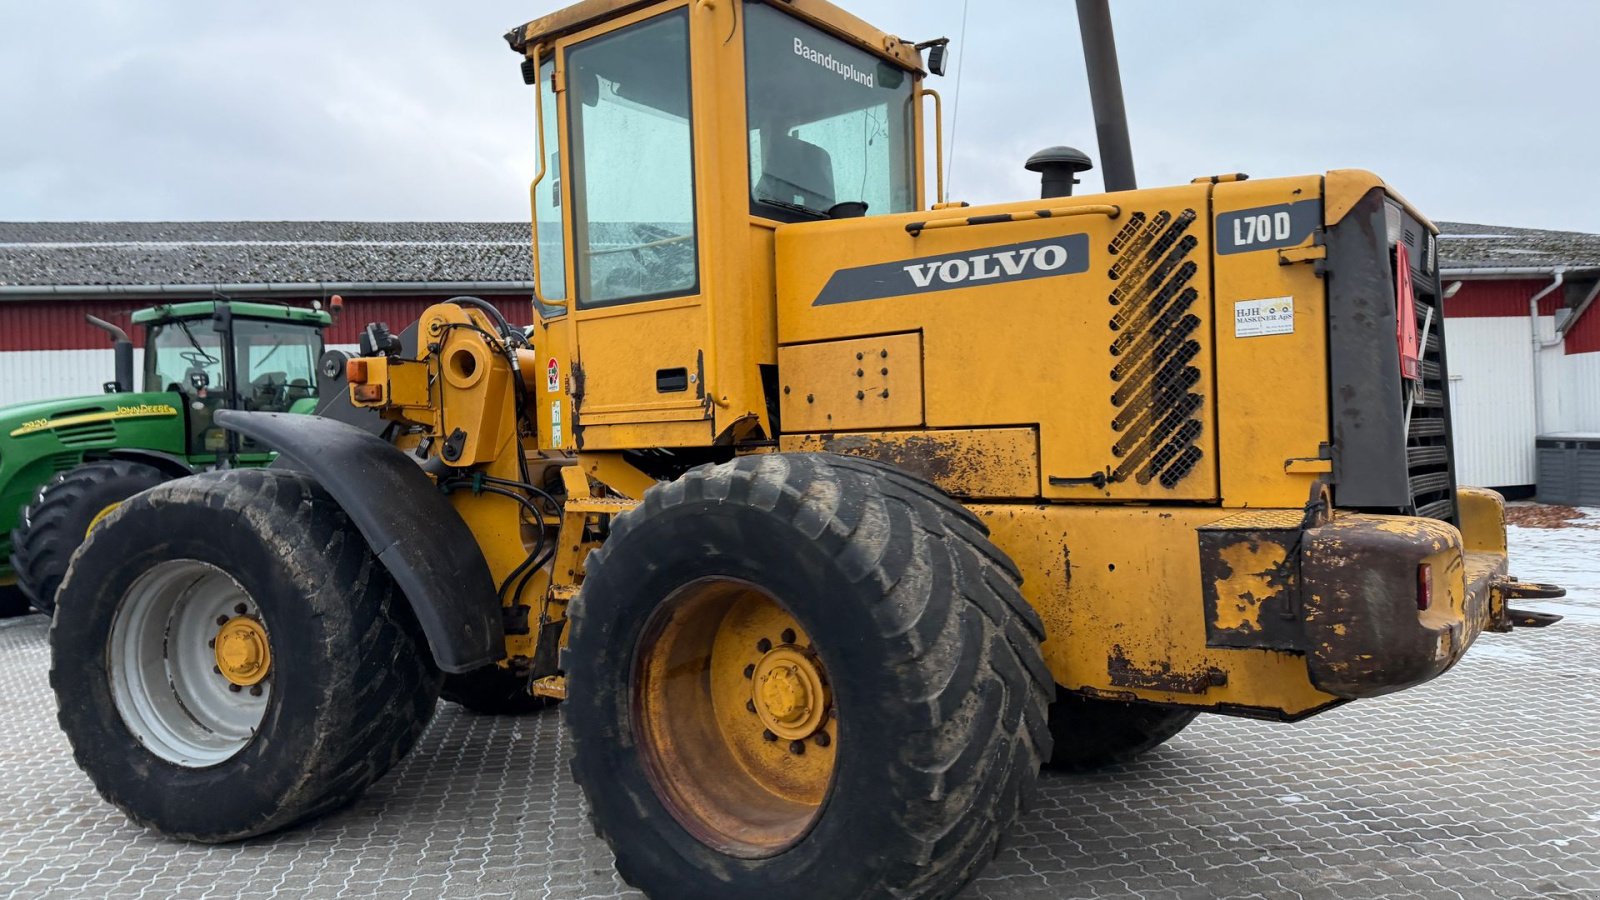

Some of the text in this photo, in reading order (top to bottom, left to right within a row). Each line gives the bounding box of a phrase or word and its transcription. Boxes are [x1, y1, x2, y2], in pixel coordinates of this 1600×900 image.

[793, 37, 874, 88] Baandruplund
[903, 244, 1068, 288] VOLVO
[1236, 307, 1261, 318] HJH
[1236, 314, 1277, 324] MASKINER
